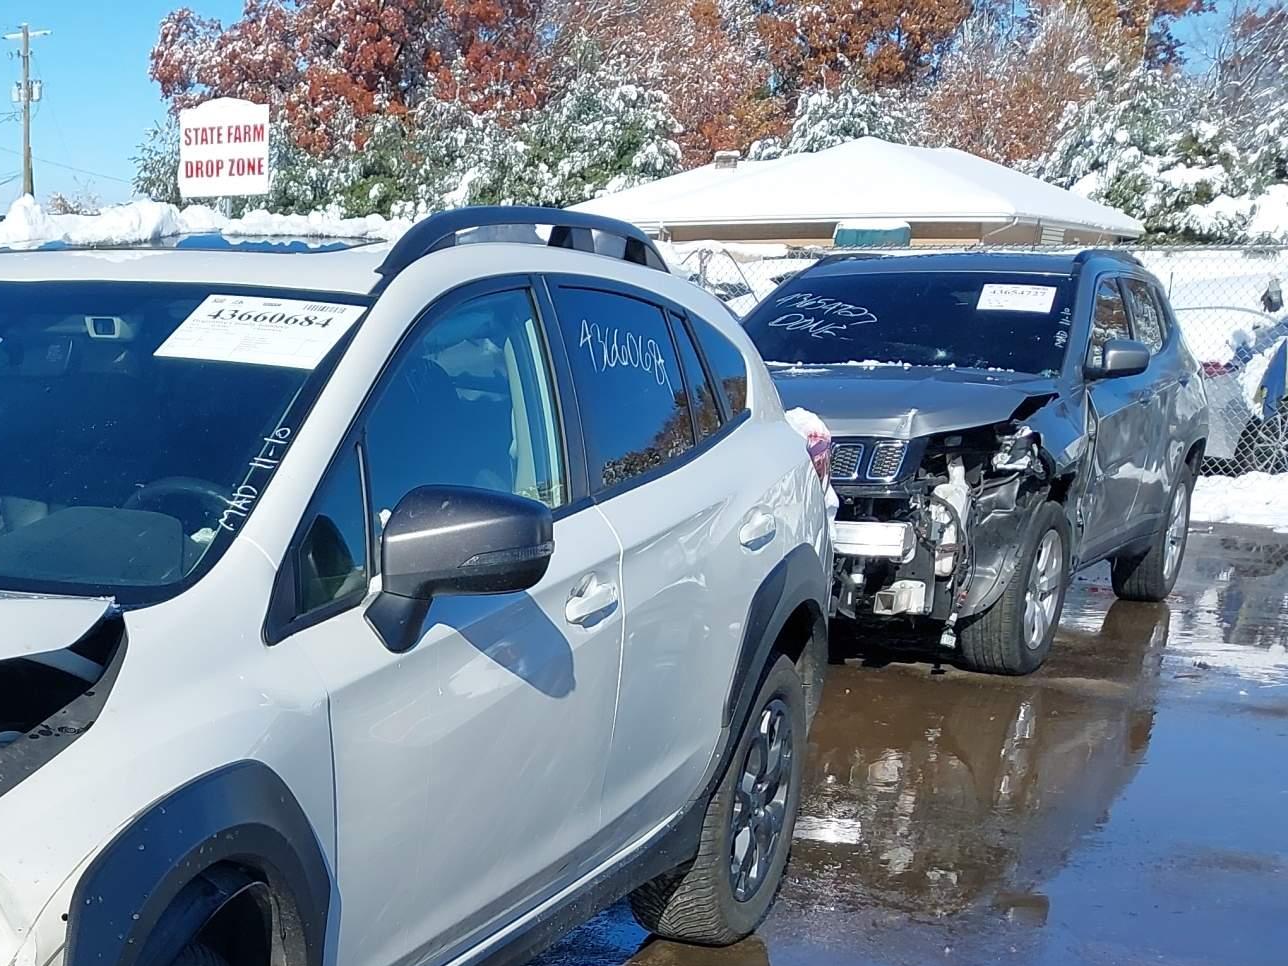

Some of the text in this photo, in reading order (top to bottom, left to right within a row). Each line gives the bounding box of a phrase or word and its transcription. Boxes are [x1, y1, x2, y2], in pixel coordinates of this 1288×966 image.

[184, 123, 265, 146] STATE FARM
[185, 157, 265, 178] DROP ZONE
[206, 308, 334, 329] 43660684
[218, 426, 292, 531] MAD 11-10
